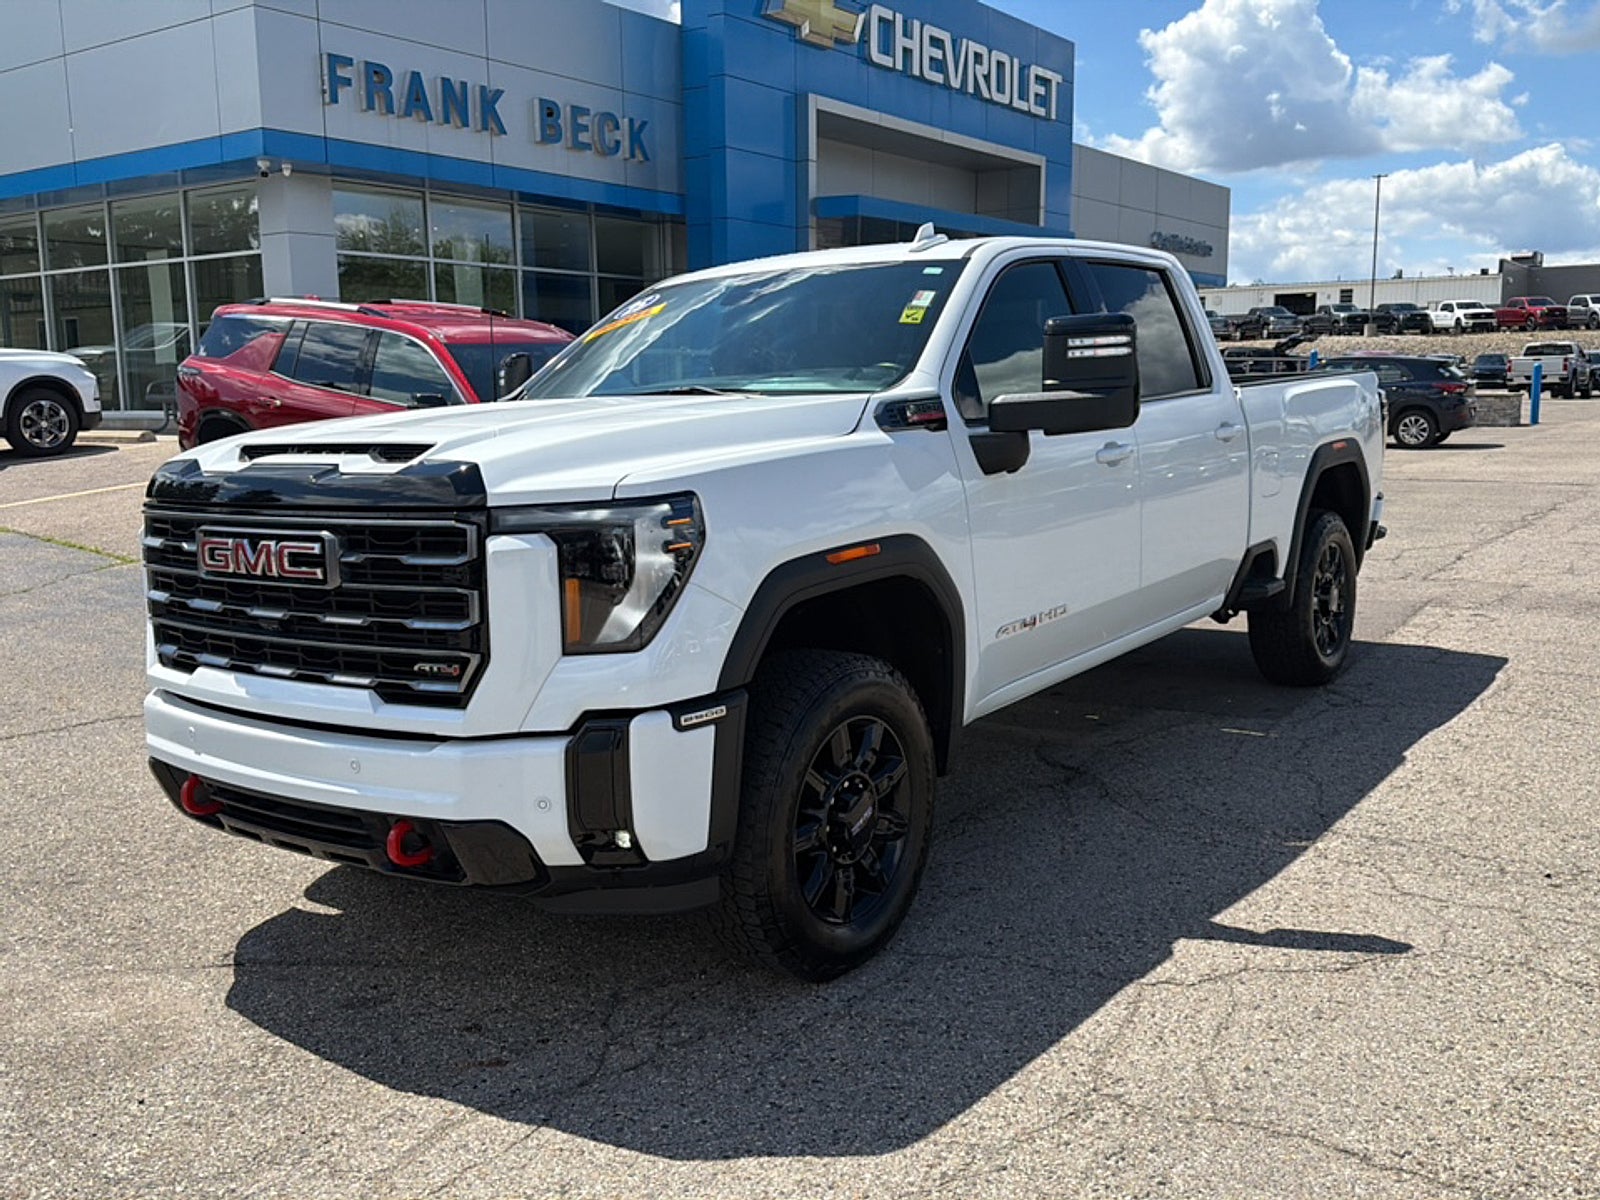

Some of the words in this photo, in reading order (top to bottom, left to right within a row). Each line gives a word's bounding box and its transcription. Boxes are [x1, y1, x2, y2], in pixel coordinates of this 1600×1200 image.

[321, 52, 507, 135] FRANK
[533, 97, 650, 161] BECK
[870, 4, 1063, 120] CHEVROLET
[200, 537, 324, 580] GMC
